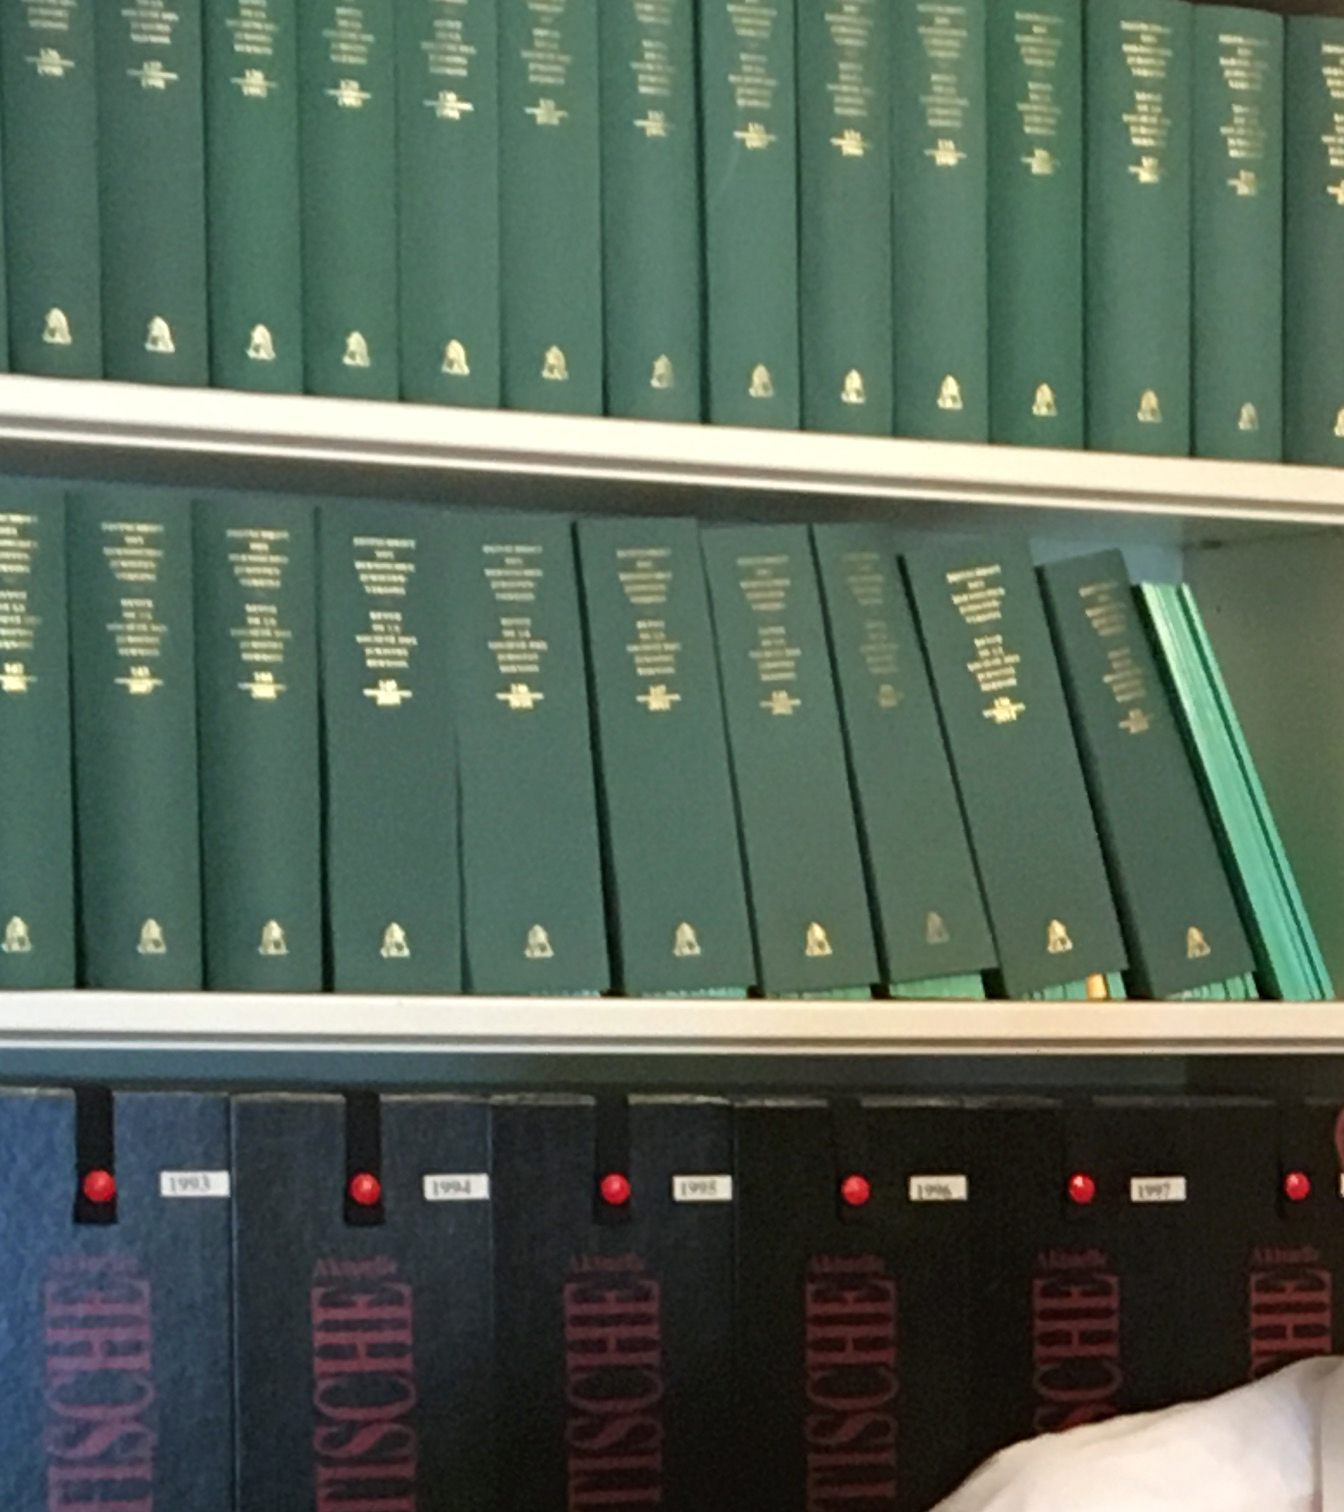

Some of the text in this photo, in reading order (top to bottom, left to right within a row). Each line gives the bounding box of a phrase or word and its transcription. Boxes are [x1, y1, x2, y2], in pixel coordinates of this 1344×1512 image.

[431, 1178, 473, 1197] 1994
[916, 1182, 954, 1200] 1996
[1137, 1182, 1172, 1199] 1997
